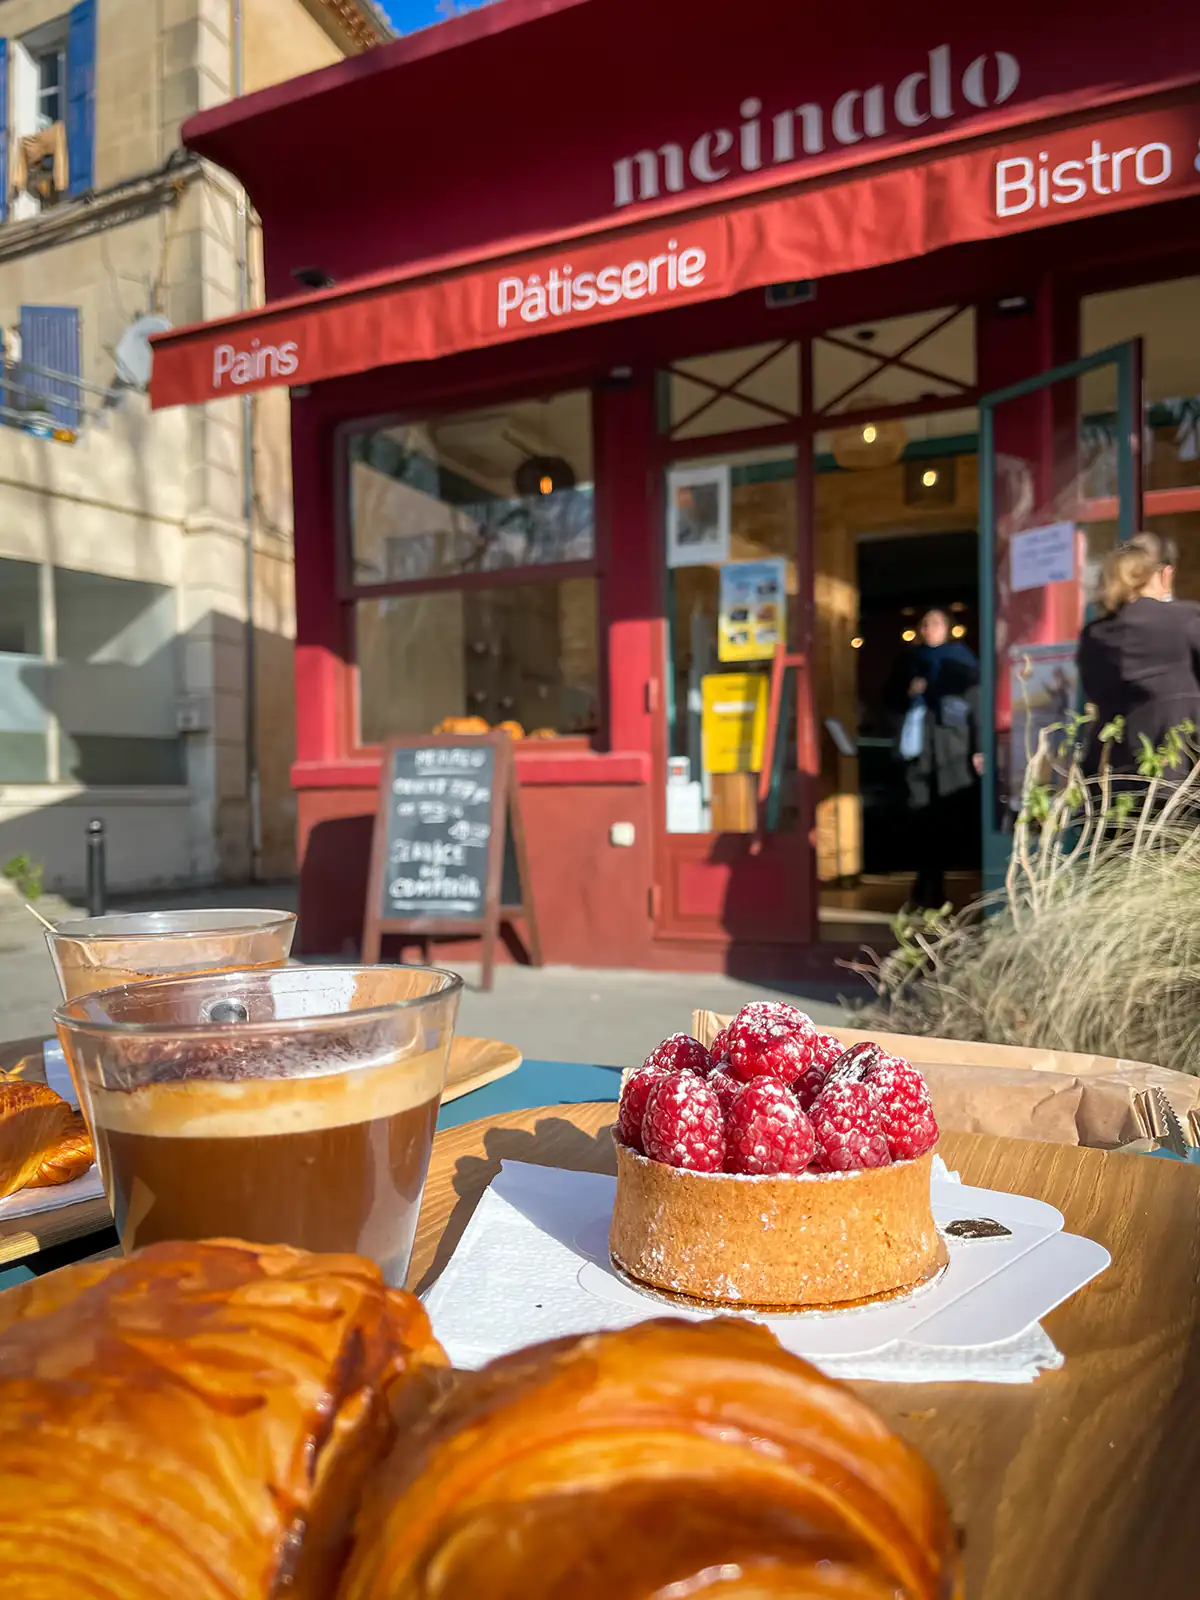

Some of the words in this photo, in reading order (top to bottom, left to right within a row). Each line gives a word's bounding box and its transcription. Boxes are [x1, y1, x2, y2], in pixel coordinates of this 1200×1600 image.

[613, 44, 1021, 207] meinado
[995, 140, 1172, 217] Bistro
[498, 239, 707, 328] Pâtisserie
[213, 338, 299, 388] Pains
